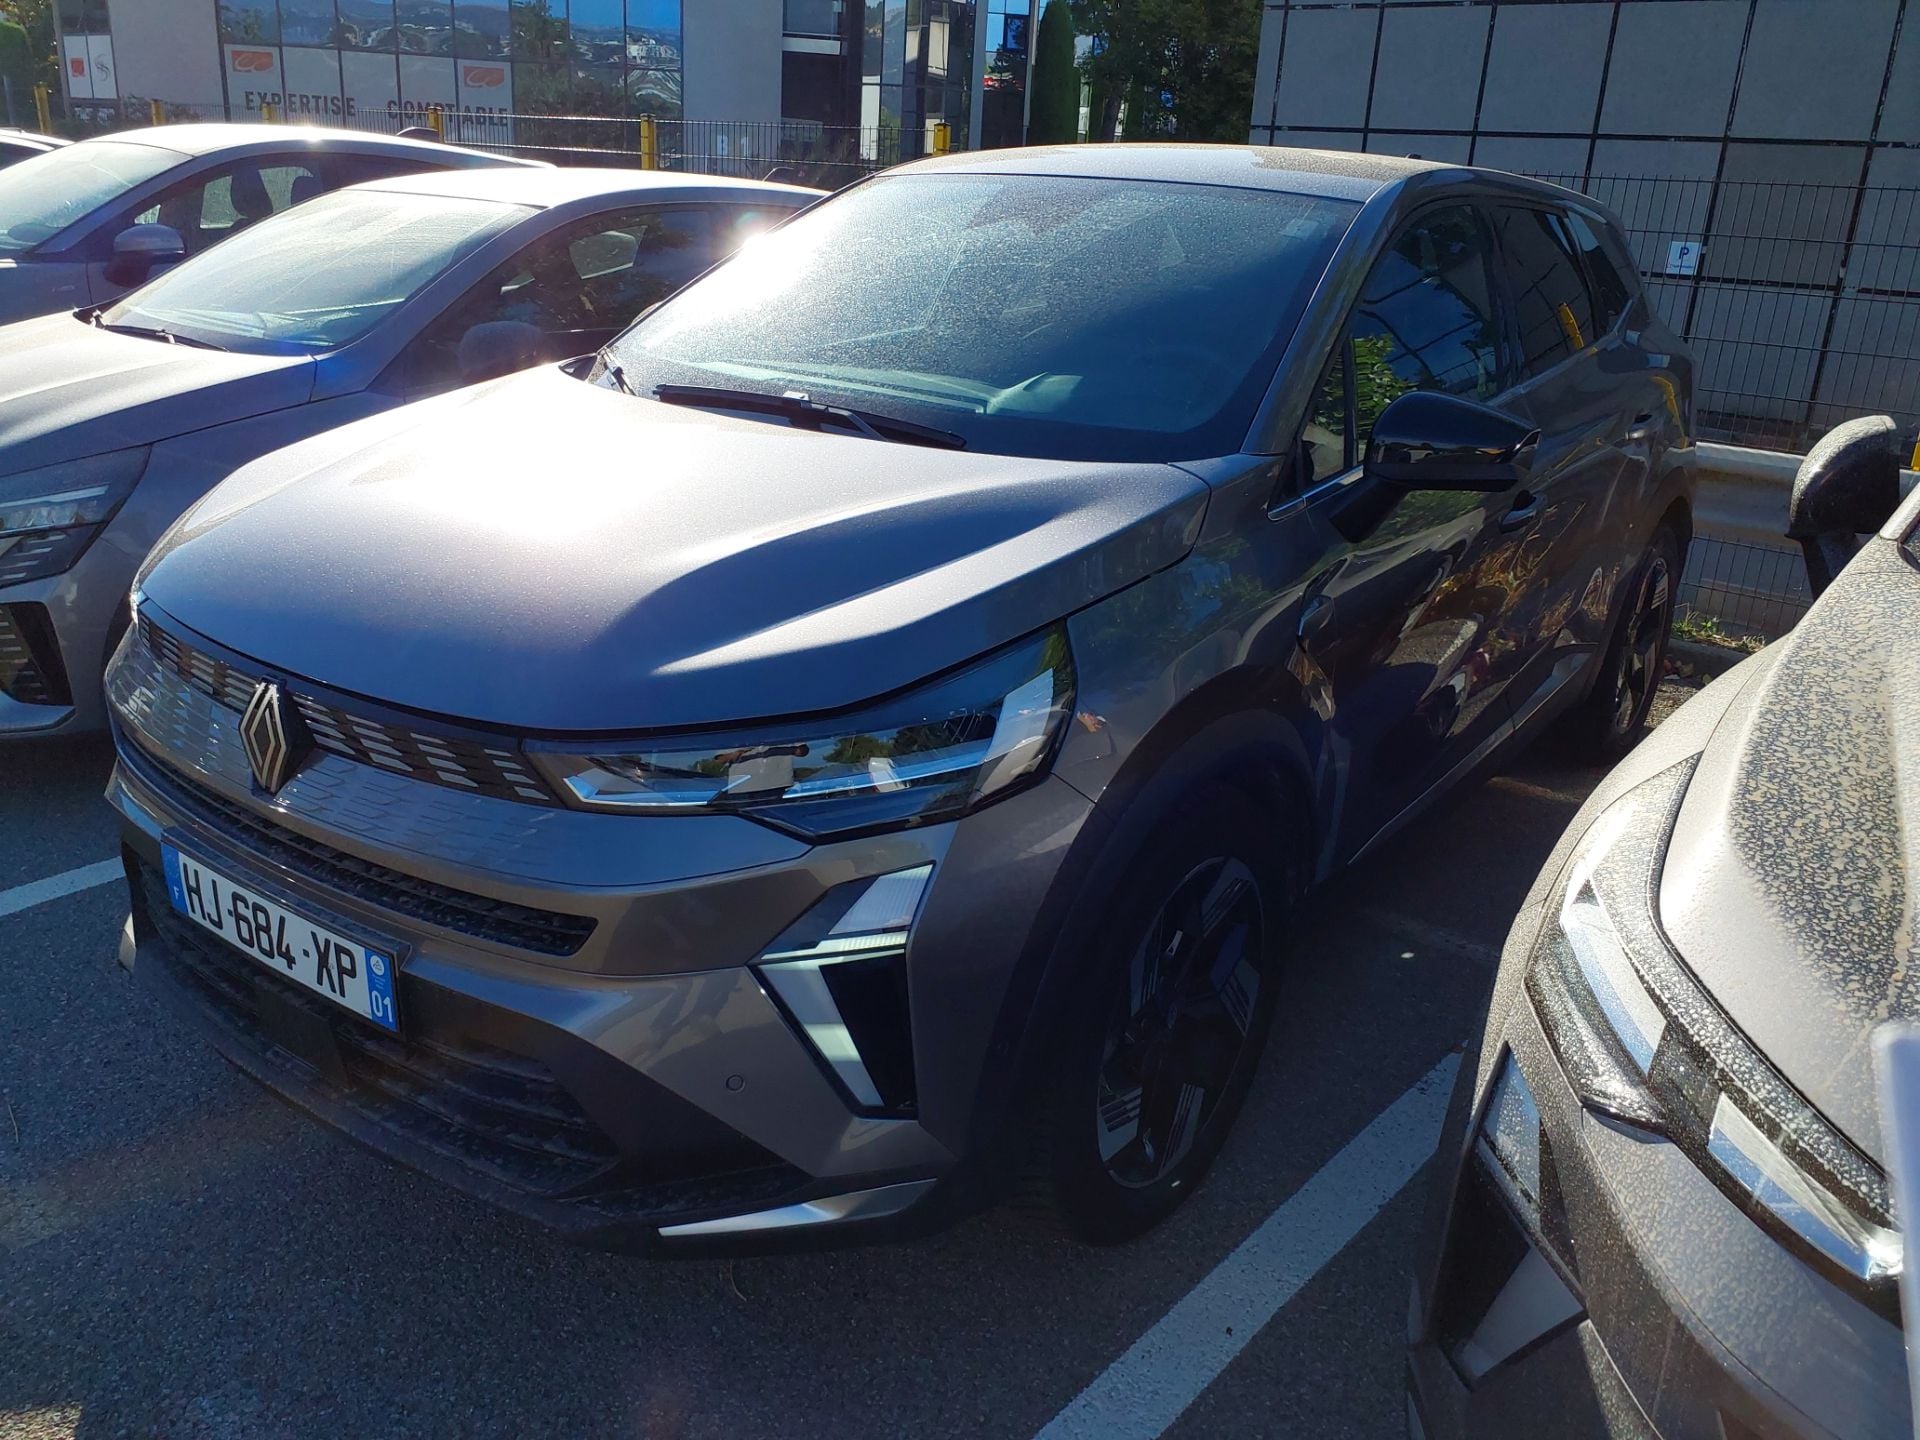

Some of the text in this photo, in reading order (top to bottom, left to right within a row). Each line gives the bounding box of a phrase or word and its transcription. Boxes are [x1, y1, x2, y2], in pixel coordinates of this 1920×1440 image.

[244, 90, 356, 117] EXPERTISE
[1678, 246, 1690, 260] P
[173, 886, 180, 900] F
[182, 862, 357, 999] HJ-684-XP
[371, 990, 393, 1023] 01
